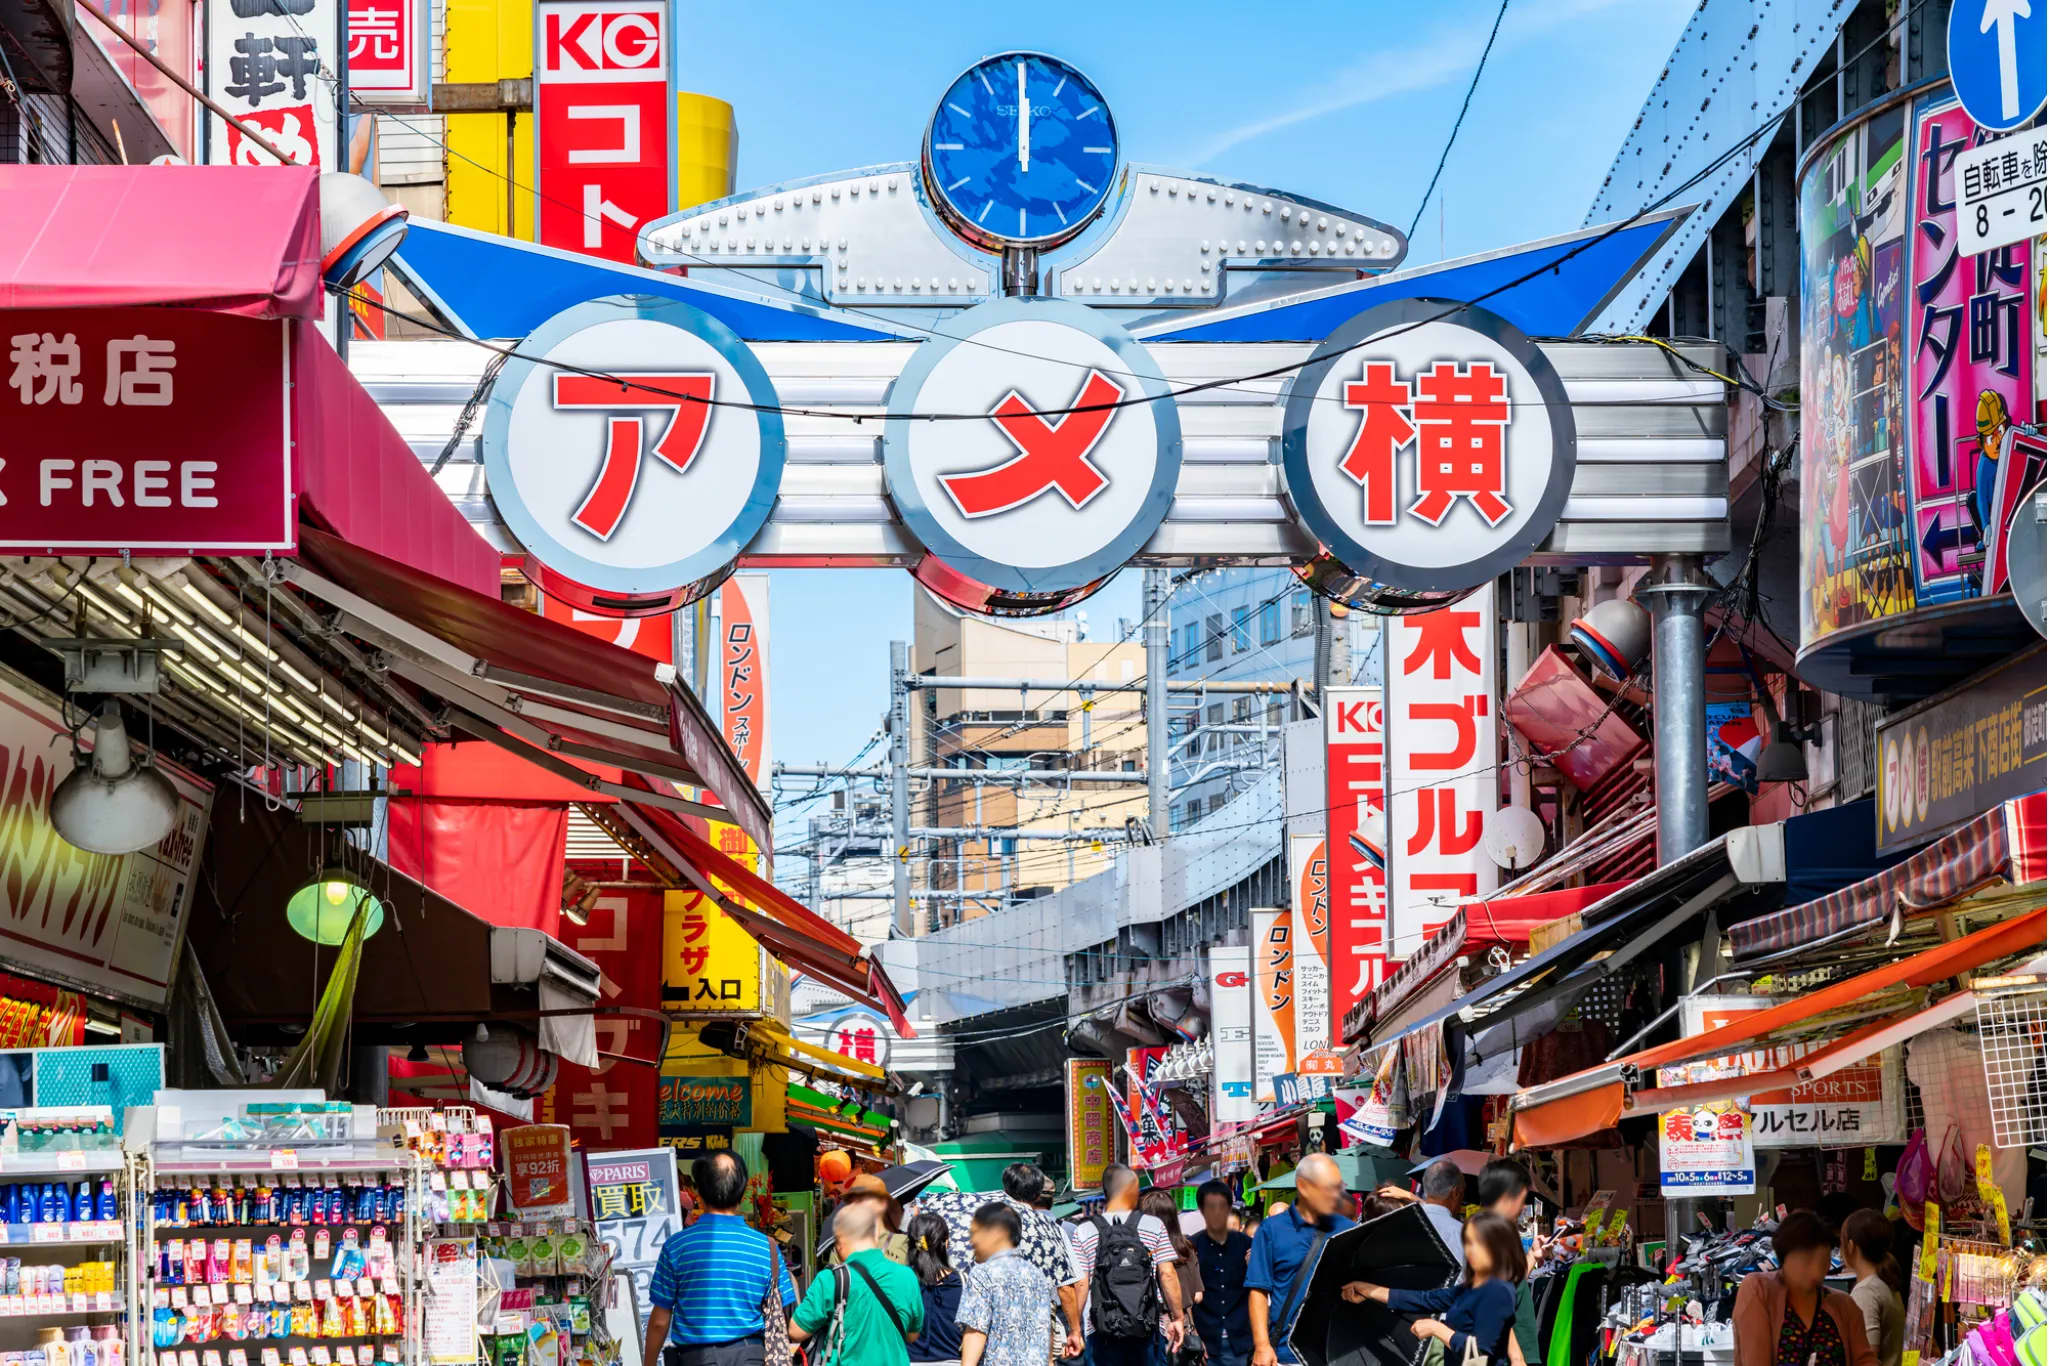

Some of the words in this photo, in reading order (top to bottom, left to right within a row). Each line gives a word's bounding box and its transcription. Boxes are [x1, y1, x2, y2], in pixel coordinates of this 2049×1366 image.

[546, 12, 660, 70] KG
[996, 105, 1051, 117] SEKO
[2029, 186, 2048, 222] 2
[39, 460, 219, 508] FREE
[728, 623, 752, 713] ロンドン
[1270, 926, 1292, 1011] ロンドン
[695, 979, 741, 1000] 入口
[1790, 1080, 1867, 1098] SPORTS
[604, 1165, 646, 1181] PARIS
[596, 1181, 665, 1218] 買取
